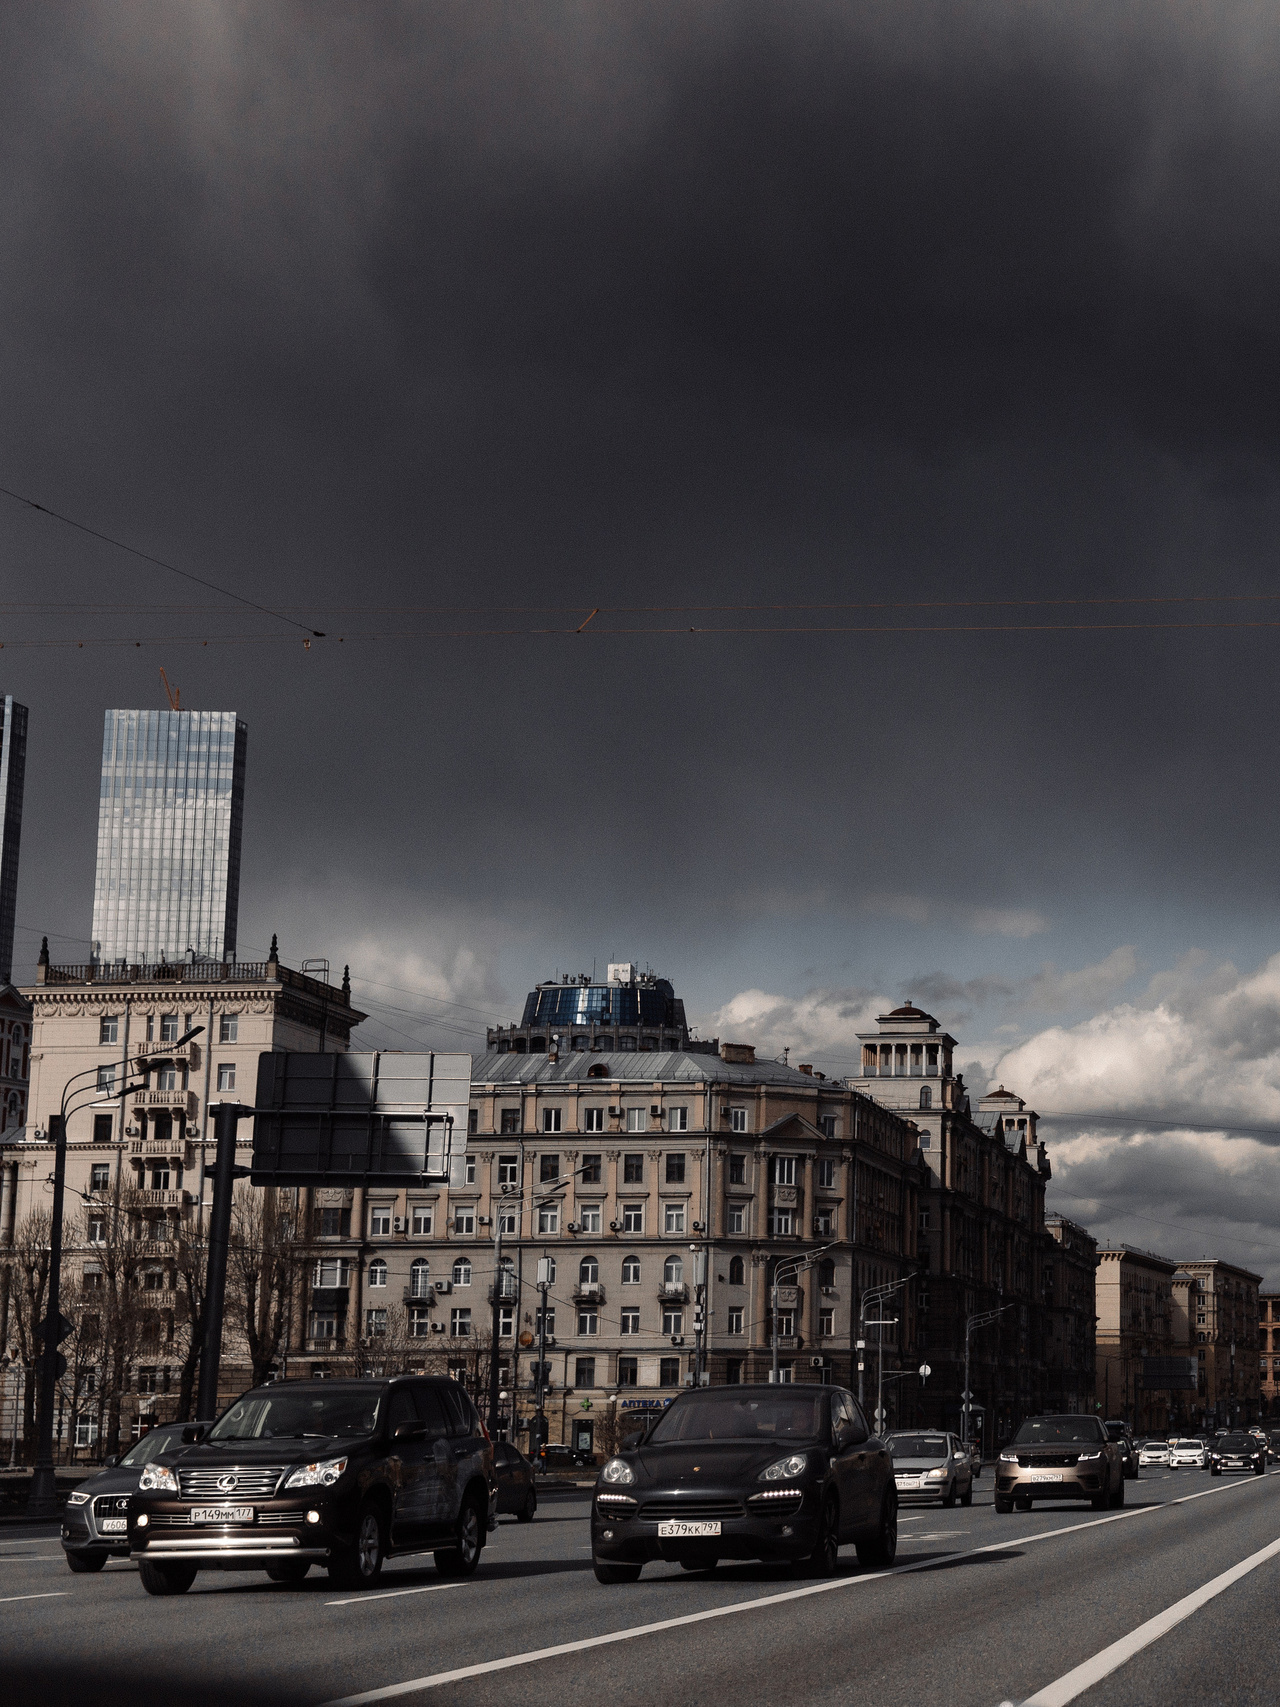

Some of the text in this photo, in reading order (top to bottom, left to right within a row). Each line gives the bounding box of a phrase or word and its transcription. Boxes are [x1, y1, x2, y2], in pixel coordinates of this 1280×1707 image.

[621, 1400, 661, 1408] АПТЕКА
[194, 1508, 251, 1520] Р149ММ 177
[661, 1522, 718, 1535] Е379КК 797
